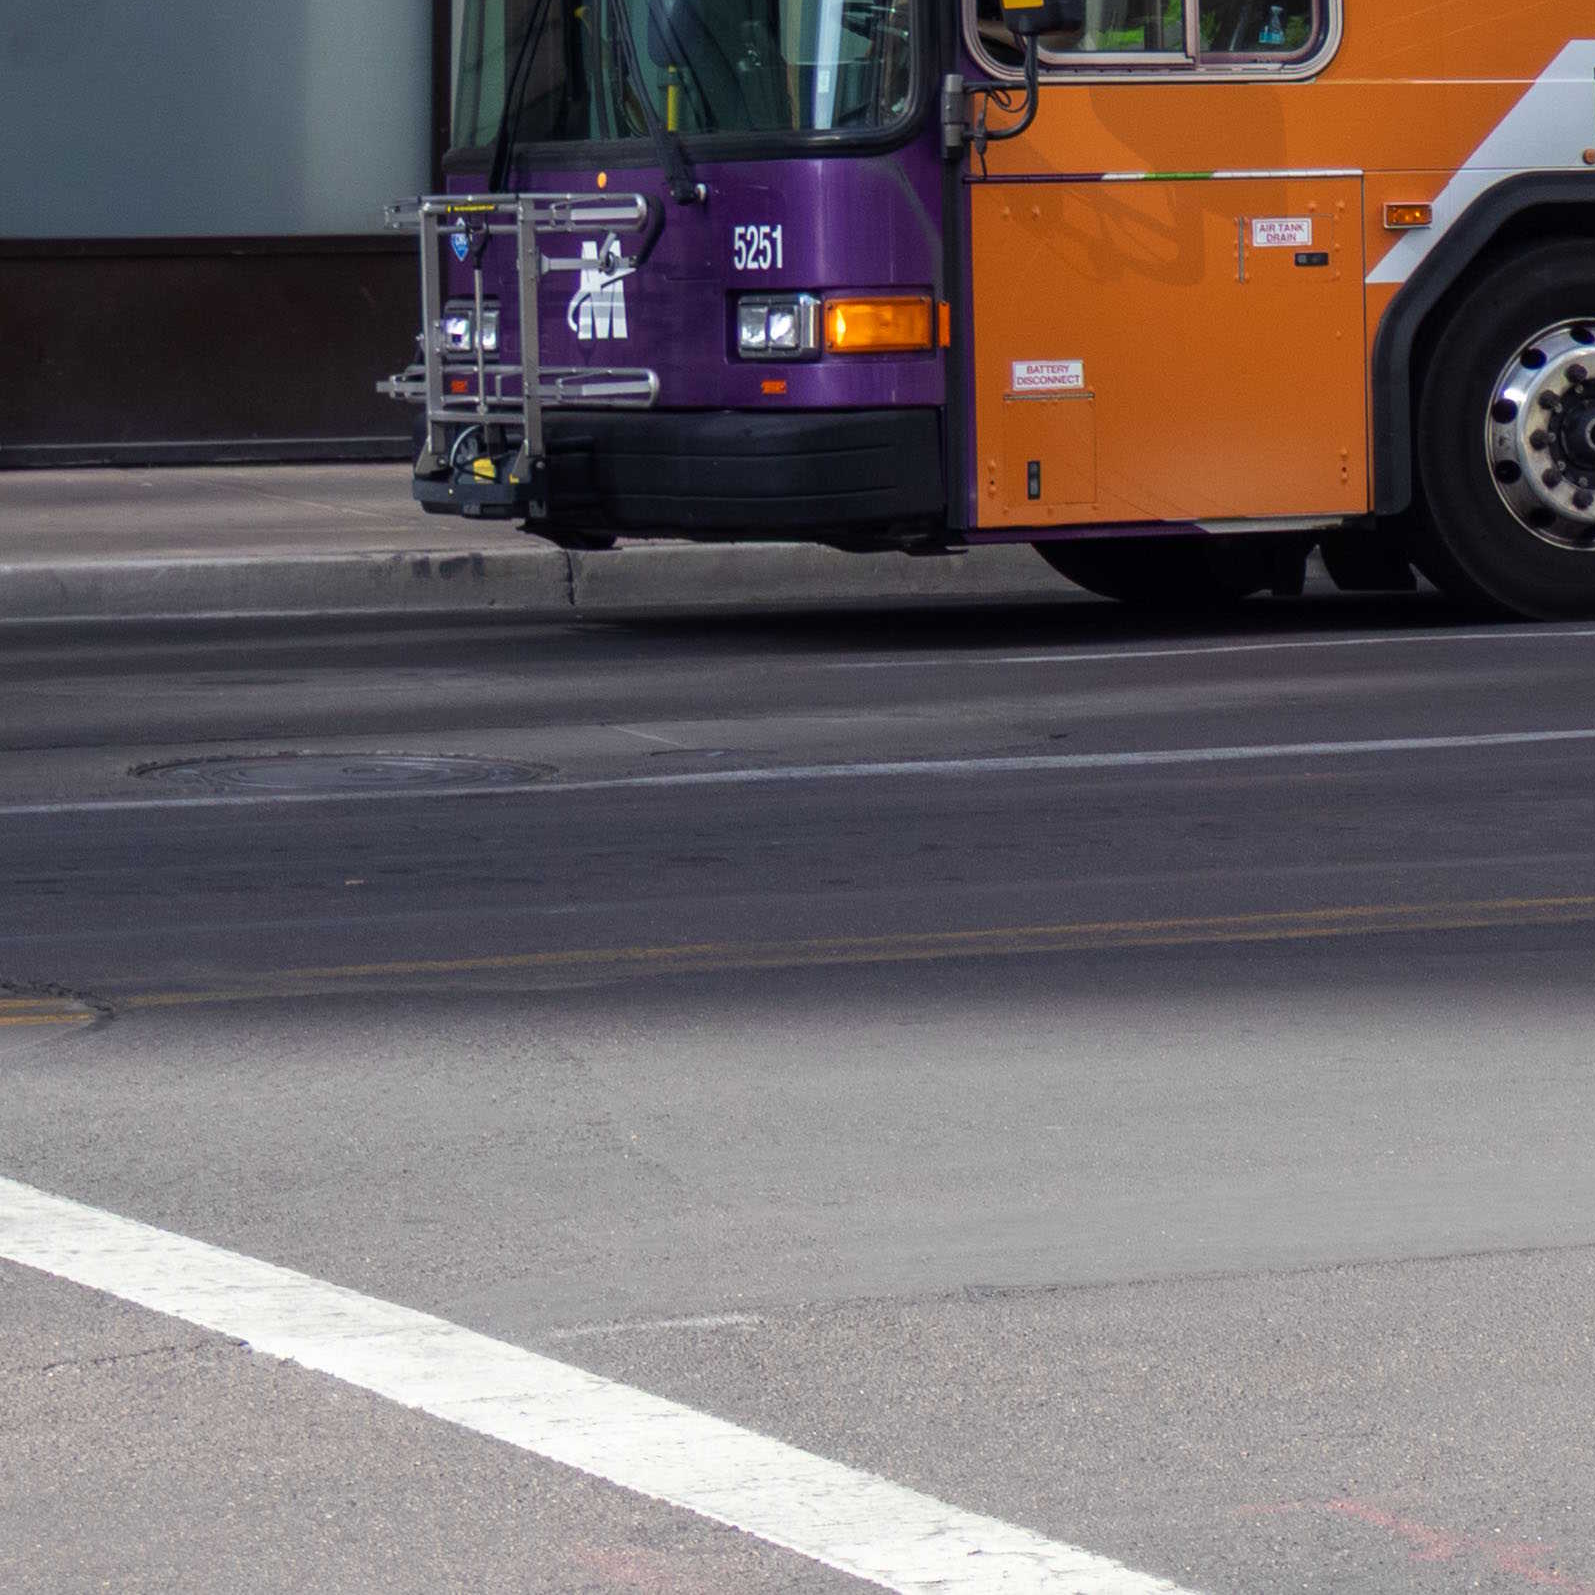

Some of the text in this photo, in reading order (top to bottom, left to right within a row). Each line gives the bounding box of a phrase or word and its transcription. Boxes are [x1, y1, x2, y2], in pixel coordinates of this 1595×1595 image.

[1260, 223, 1304, 233] AIR TANK
[1266, 233, 1297, 243] DRAIN
[733, 223, 784, 271] 5251
[1026, 364, 1069, 374] BATTERY
[1016, 374, 1080, 386] DISCONNECT
